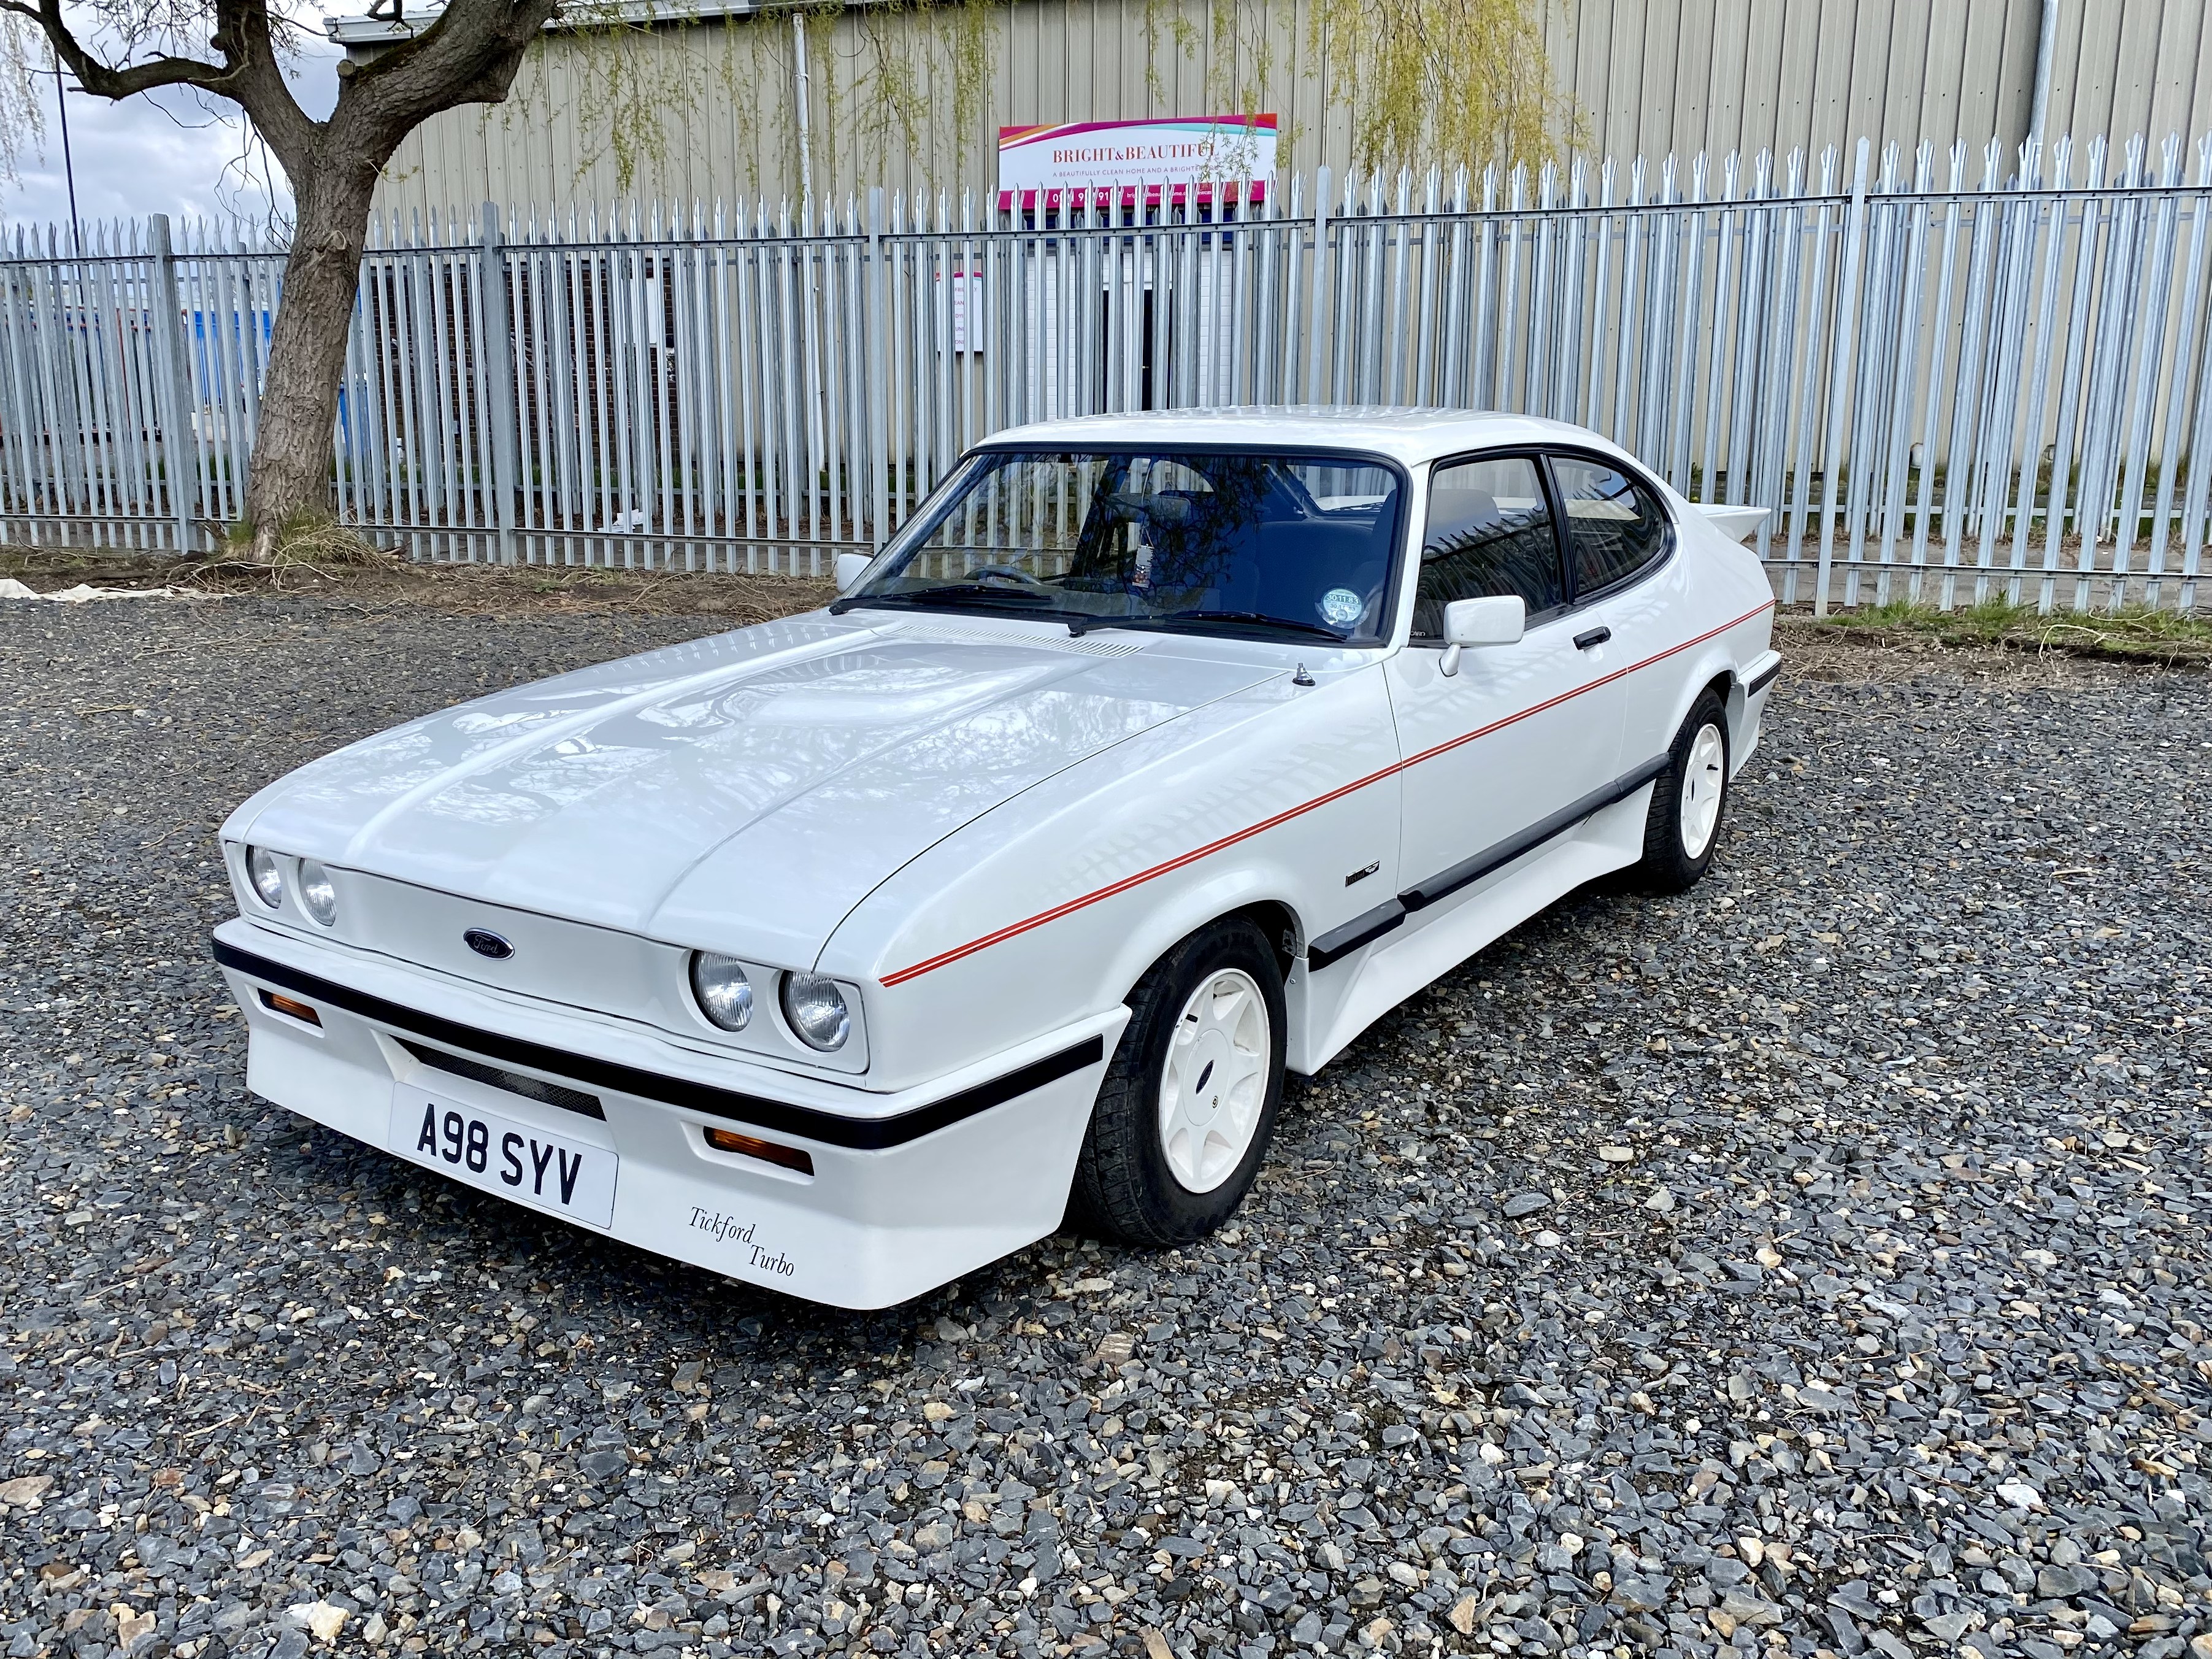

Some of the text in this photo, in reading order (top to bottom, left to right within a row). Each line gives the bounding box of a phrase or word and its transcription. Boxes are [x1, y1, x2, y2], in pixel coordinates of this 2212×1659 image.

[473, 934, 499, 954] Ford
[417, 1103, 583, 1206] A98 SYV
[688, 1206, 756, 1244] Tickford
[748, 1244, 794, 1276] Turbo
